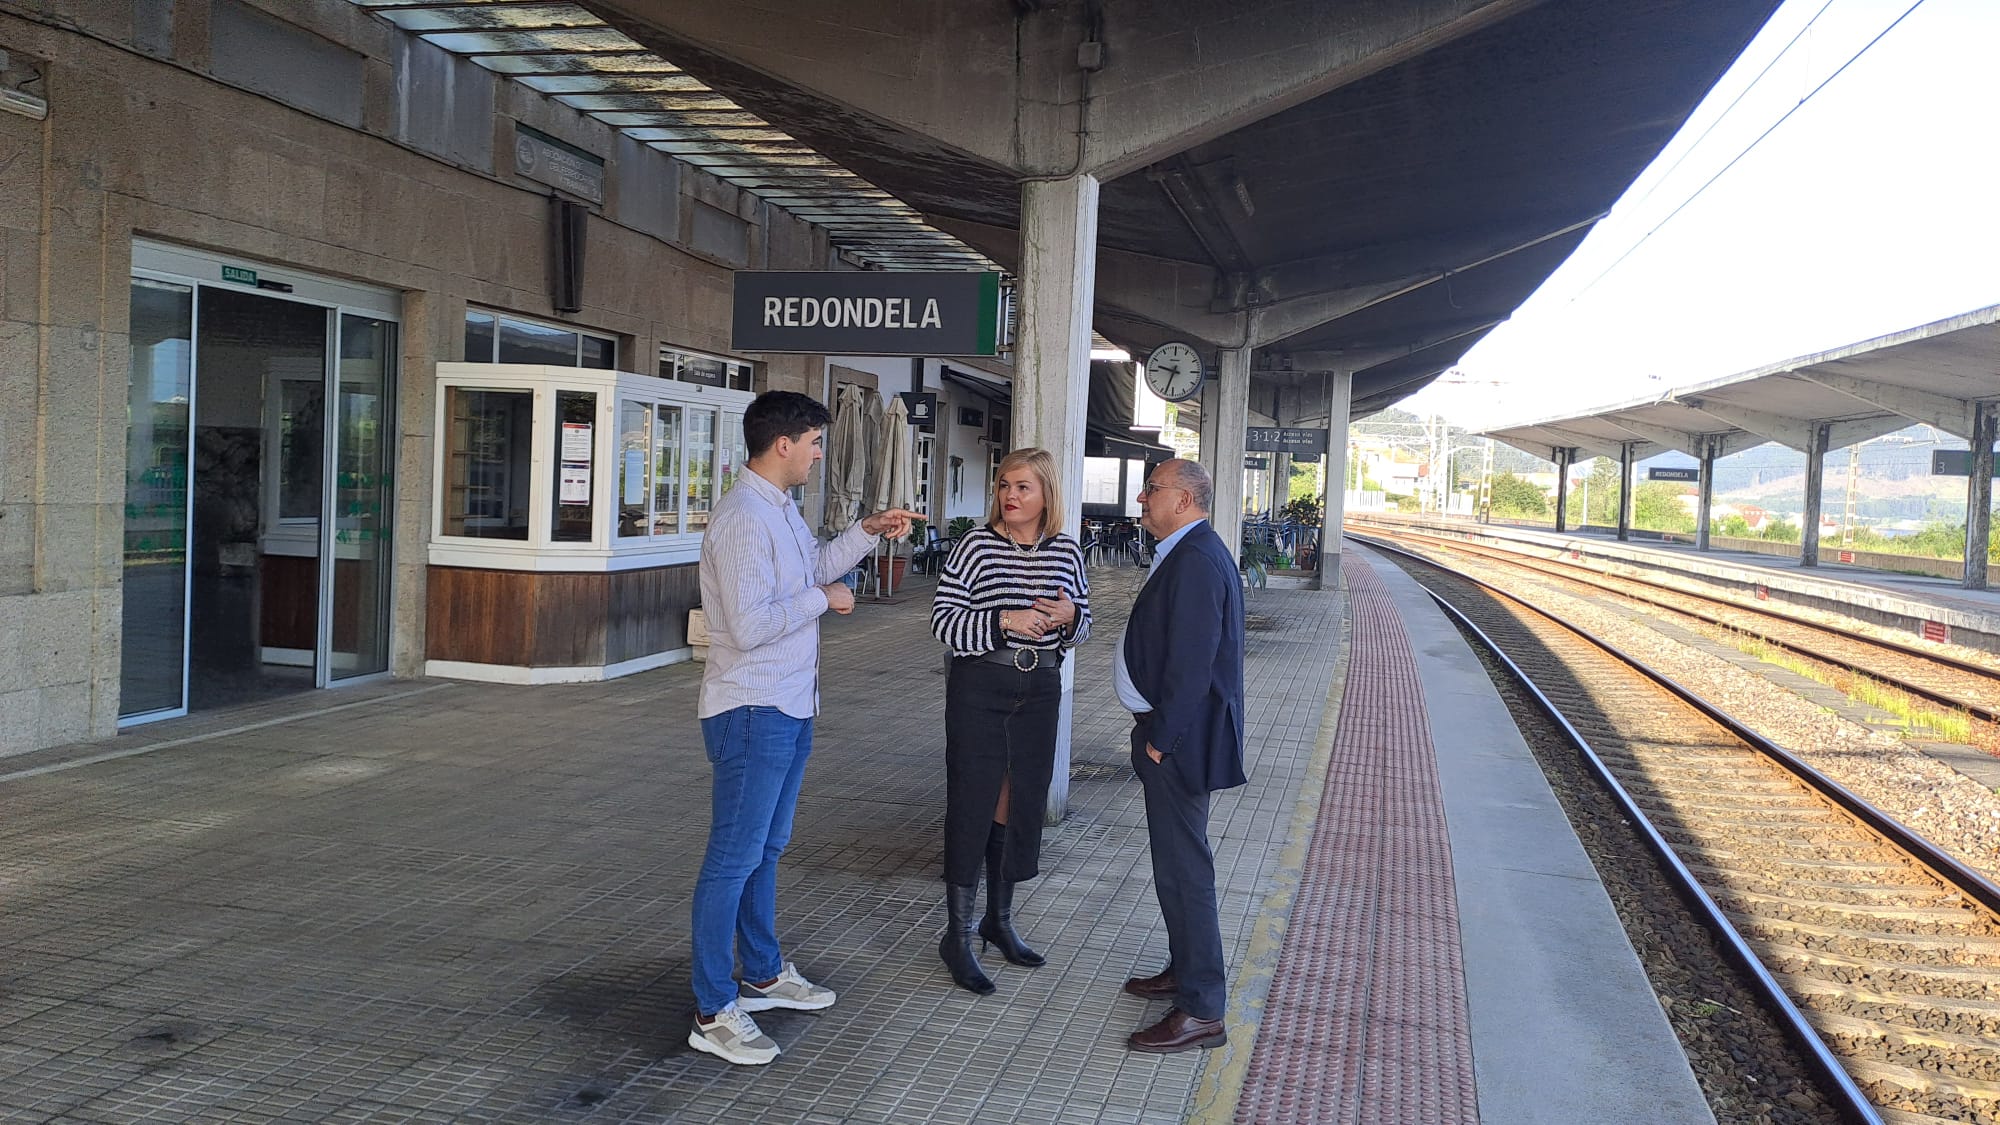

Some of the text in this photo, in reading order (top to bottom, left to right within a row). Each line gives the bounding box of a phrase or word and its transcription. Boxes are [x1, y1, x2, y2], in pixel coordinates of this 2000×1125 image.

[225, 267, 254, 283] SALIDA
[763, 296, 942, 329] REDONDELA
[1938, 462, 1945, 473] 3
[1655, 471, 1689, 479] REDONDELA
